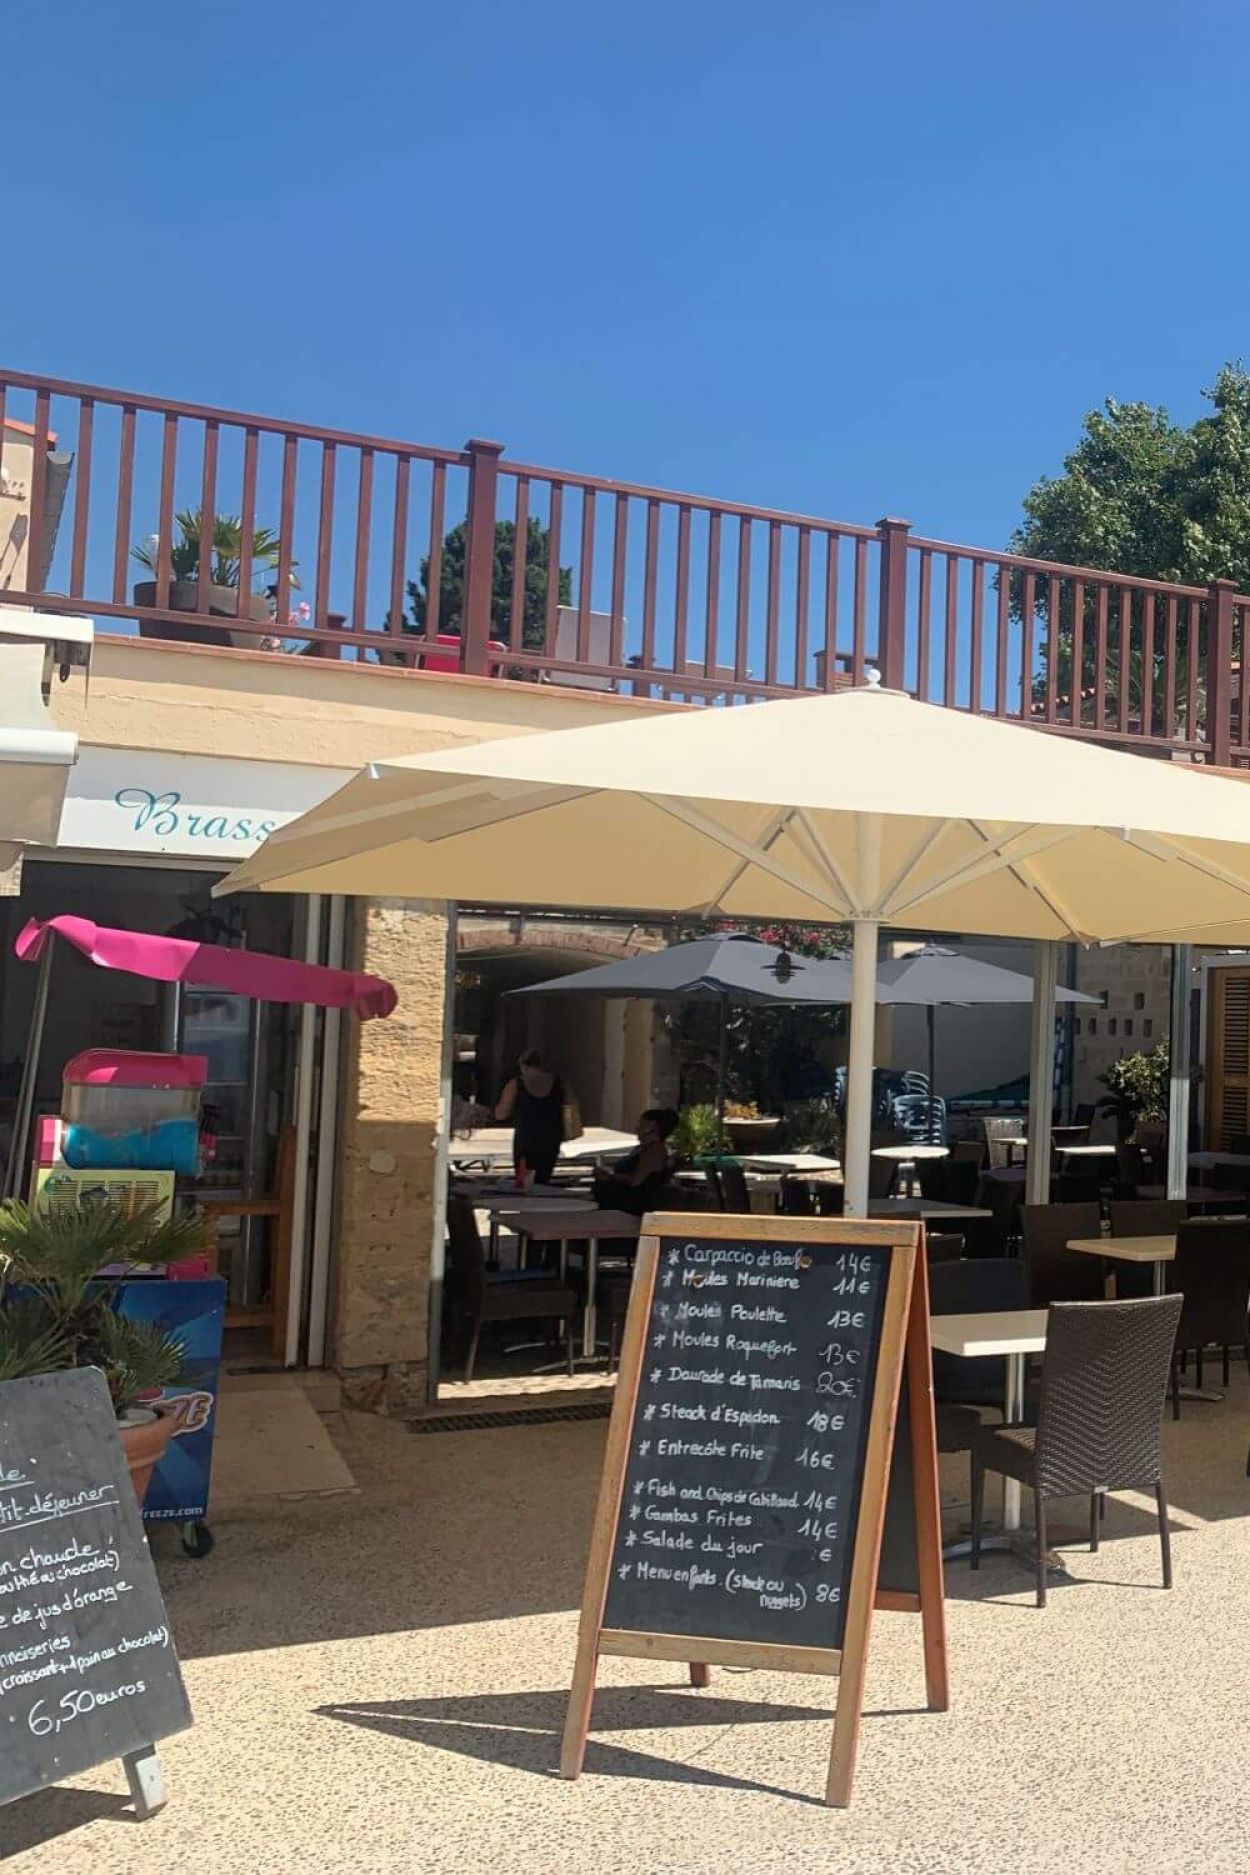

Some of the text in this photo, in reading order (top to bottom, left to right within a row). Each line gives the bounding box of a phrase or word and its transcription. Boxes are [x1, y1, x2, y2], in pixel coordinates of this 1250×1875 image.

[684, 1244, 754, 1267] Carpaccio
[836, 1252, 871, 1275] 14€
[682, 1269, 728, 1289] Moules
[832, 1277, 871, 1295] 11€
[675, 1301, 865, 1328] Moules Poulette 13€
[672, 1330, 860, 1365] Moules Roquefort 13€
[667, 1366, 725, 1384] Daurade
[730, 1370, 746, 1386] de
[749, 1374, 800, 1391] Tamaris
[807, 1410, 845, 1432] 18€
[731, 1443, 764, 1460] Frite
[795, 1448, 835, 1470] 16€
[648, 1479, 676, 1497] Fish
[680, 1485, 702, 1500] and
[803, 1490, 838, 1512] 14€
[645, 1505, 838, 1541] Gambas Frites 14€
[640, 1530, 694, 1550] Salade
[700, 1535, 723, 1552] du
[727, 1536, 764, 1558] jour
[815, 1583, 841, 1603] 8€
[12, 1606, 33, 1625] de
[34, 1603, 62, 1630] jus
